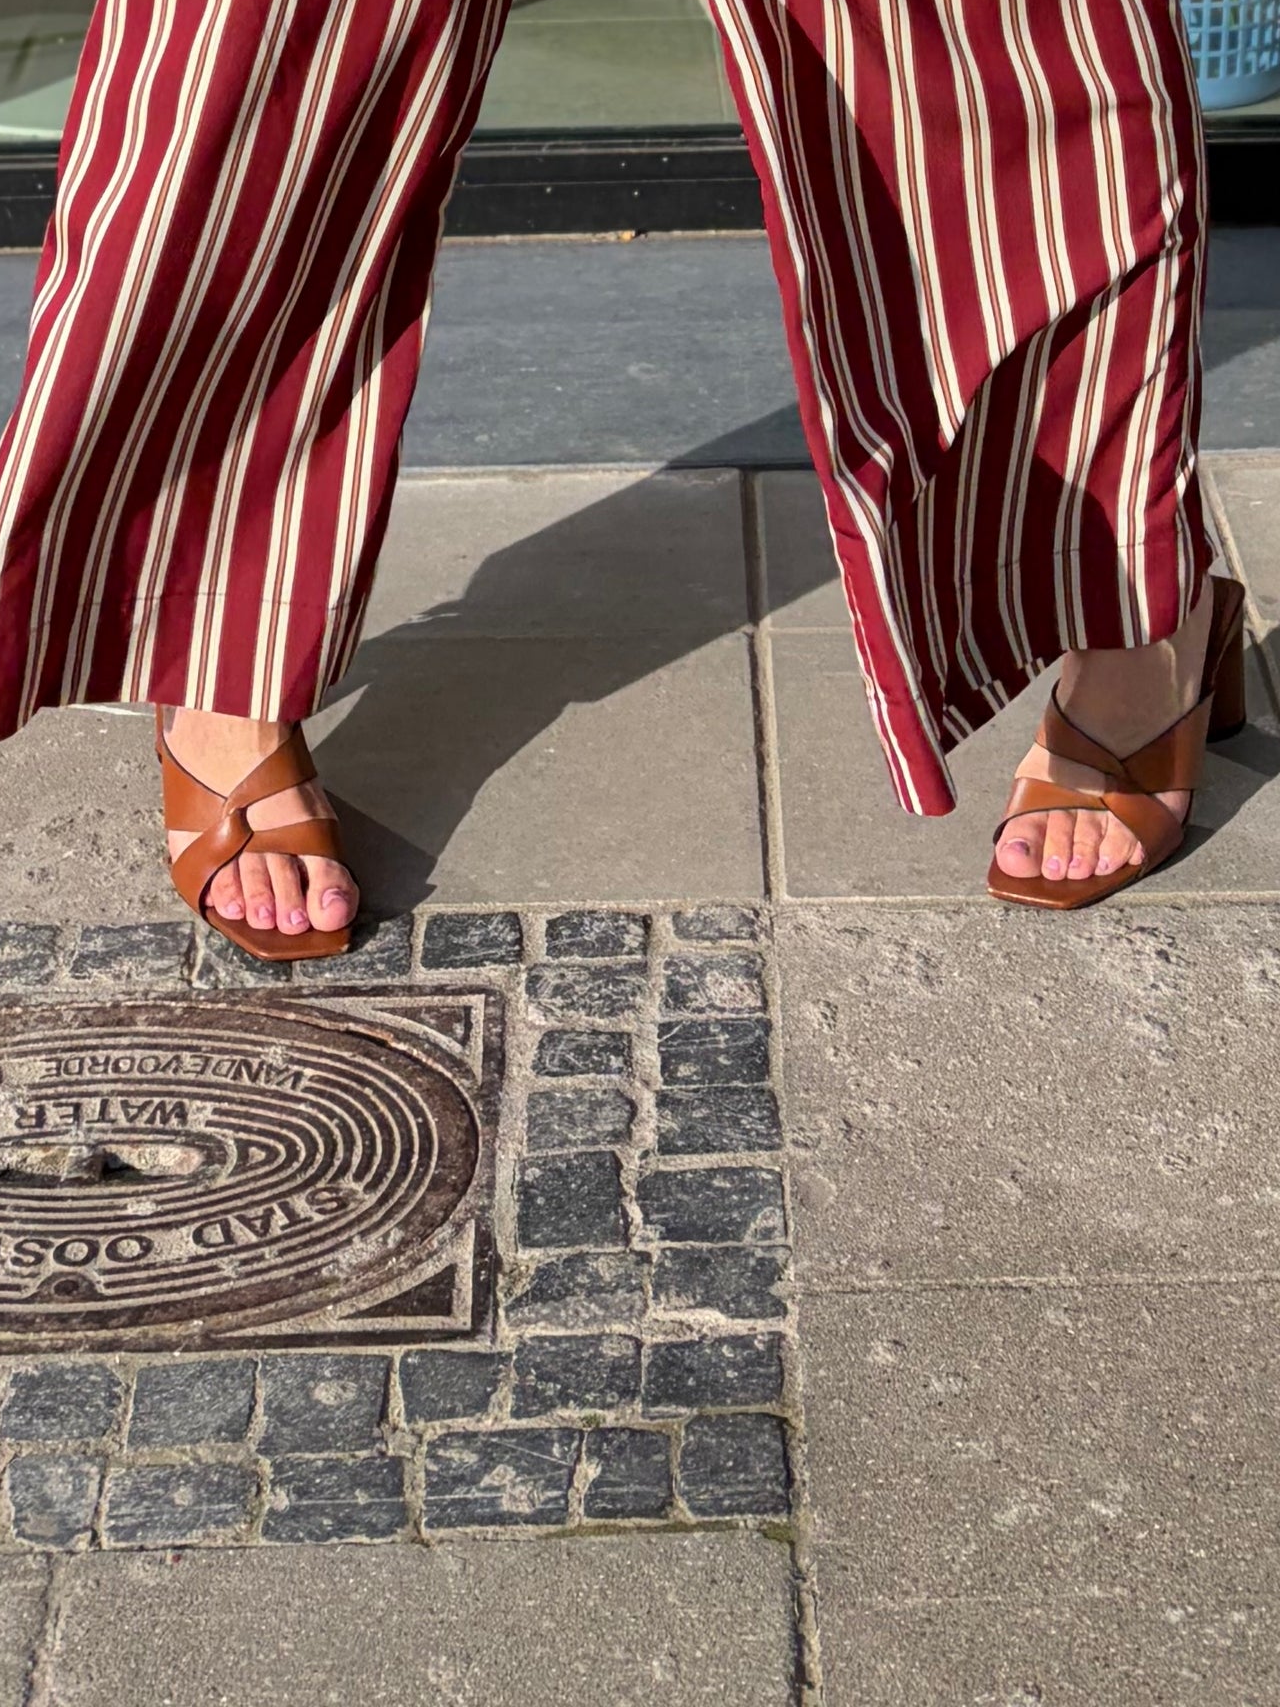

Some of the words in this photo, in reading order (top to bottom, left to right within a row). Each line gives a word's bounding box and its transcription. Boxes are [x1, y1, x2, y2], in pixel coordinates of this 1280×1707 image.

[42, 1054, 314, 1089] VANDEVOORDE
[15, 1097, 189, 1128] WATER
[192, 1187, 349, 1249] STAD
